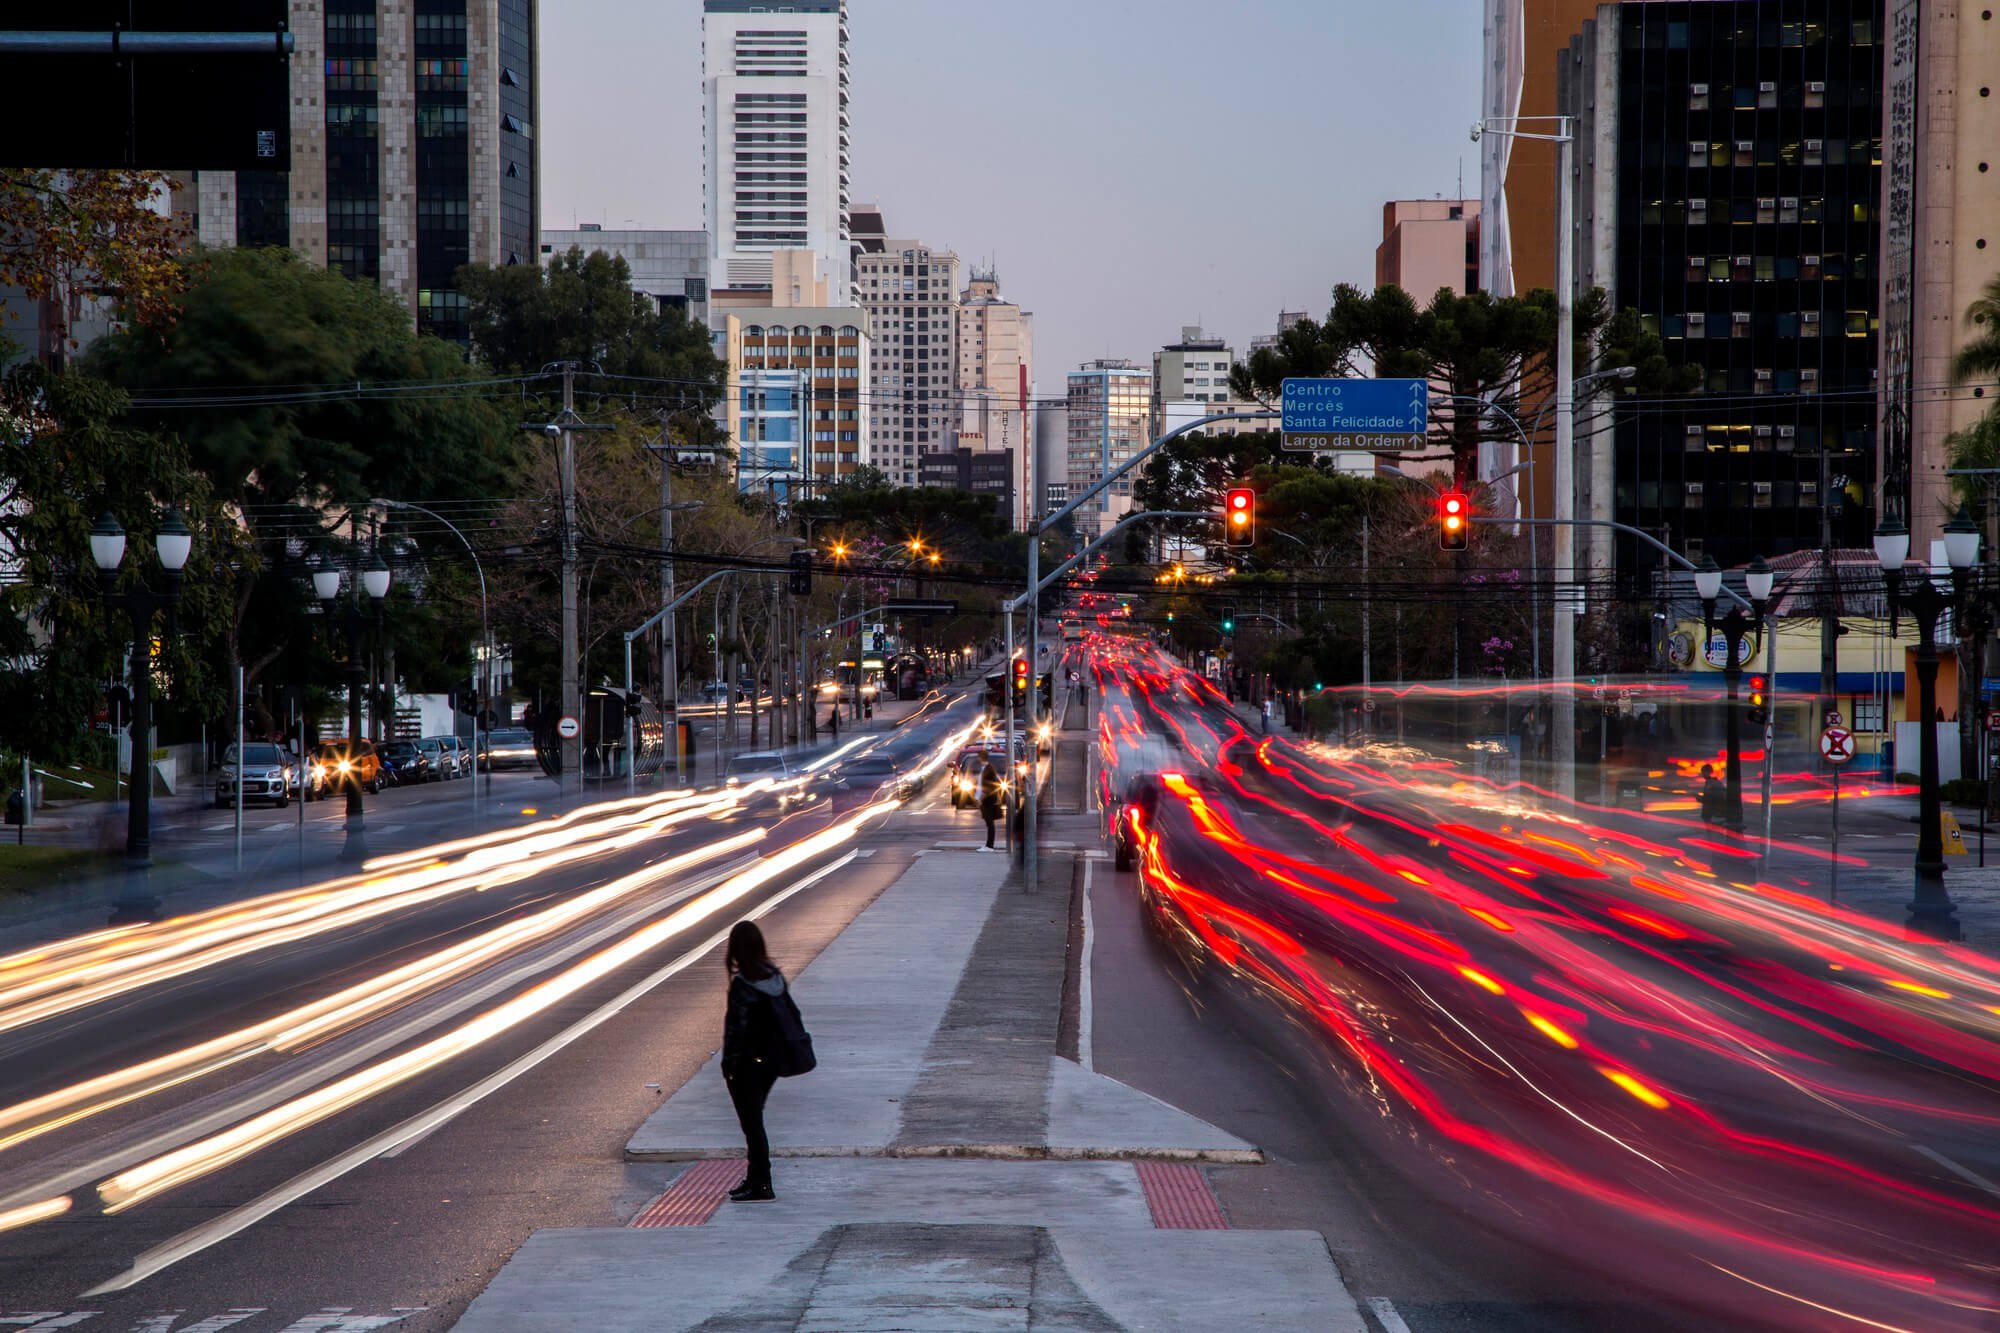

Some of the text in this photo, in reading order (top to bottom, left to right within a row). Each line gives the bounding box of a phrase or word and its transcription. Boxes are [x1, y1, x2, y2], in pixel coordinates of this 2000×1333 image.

[1285, 383, 1342, 396] Centro
[1285, 399, 1344, 412] Mercês
[1284, 416, 1405, 428] Santa Felicidade
[1284, 434, 1405, 449] Largo da Ordem
